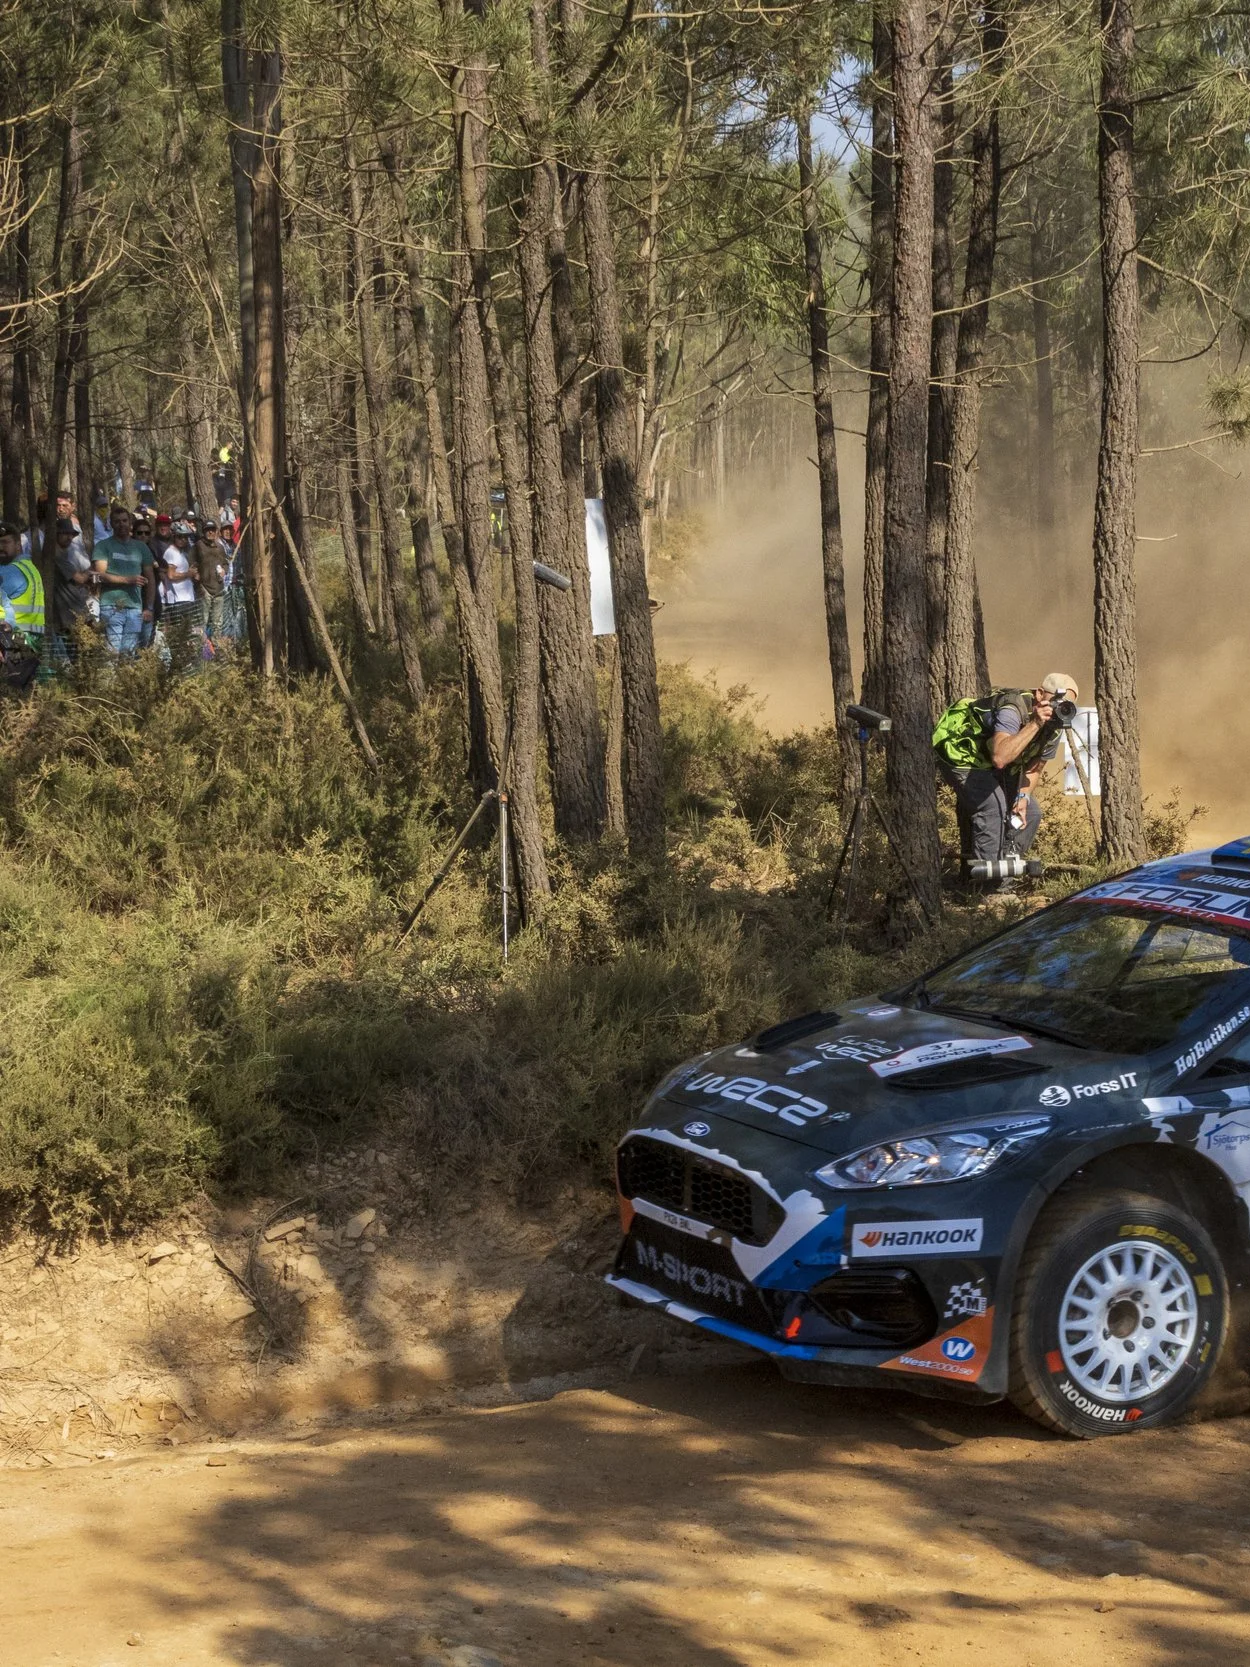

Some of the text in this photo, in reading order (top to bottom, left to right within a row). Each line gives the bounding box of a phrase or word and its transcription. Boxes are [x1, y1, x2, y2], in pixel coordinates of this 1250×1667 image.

[685, 1072, 829, 1127] WRC2
[1072, 1072, 1138, 1099] Forss IT
[882, 1228, 978, 1247] HANKOOK
[1059, 1379, 1126, 1422] HANKOOK
